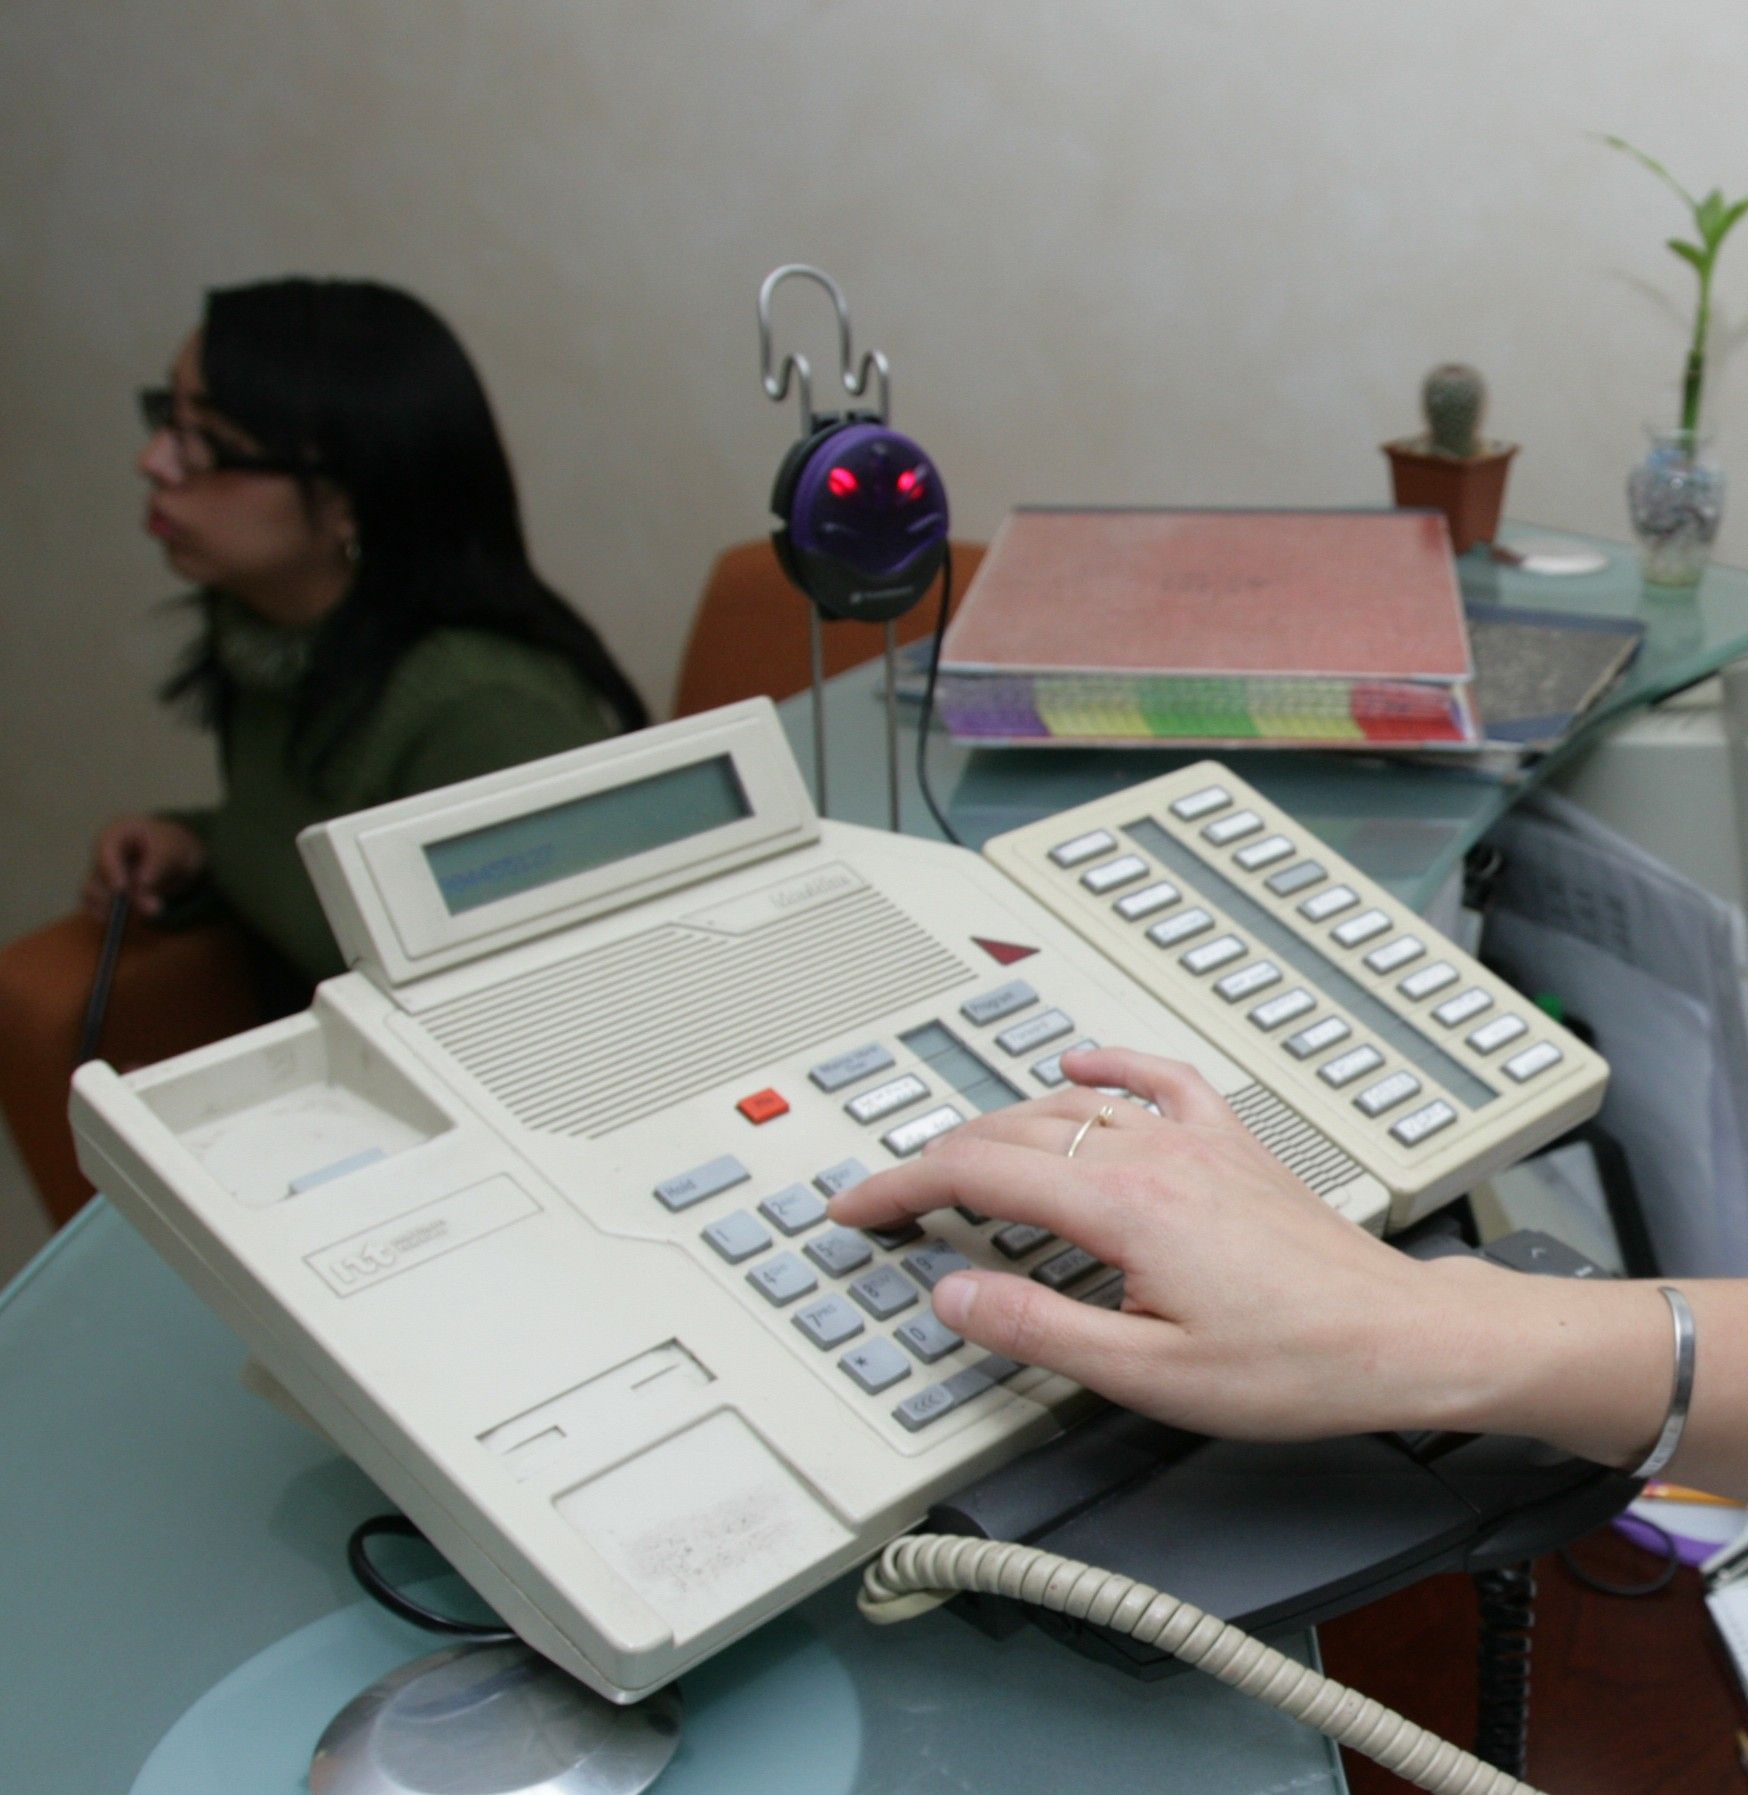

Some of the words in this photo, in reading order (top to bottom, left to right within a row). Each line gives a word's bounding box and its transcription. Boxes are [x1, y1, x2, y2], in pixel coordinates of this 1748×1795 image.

[771, 1200, 787, 1216] 2
[715, 1229, 730, 1243] 1
[816, 1241, 832, 1258] 5
[763, 1270, 777, 1284] 4
[862, 1282, 880, 1299] 8
[806, 1313, 822, 1328] 7
[909, 1327, 926, 1342] 0
